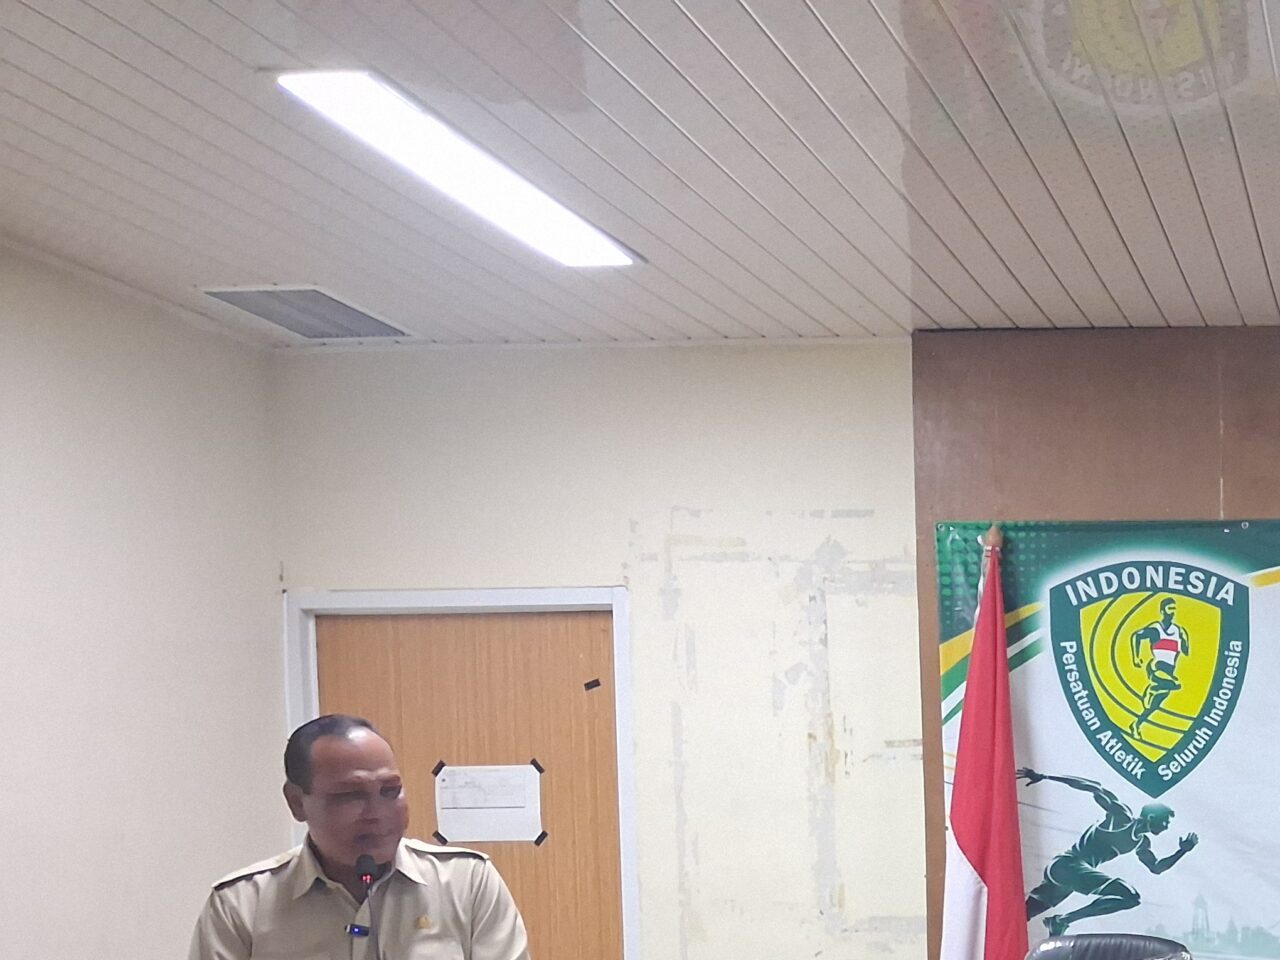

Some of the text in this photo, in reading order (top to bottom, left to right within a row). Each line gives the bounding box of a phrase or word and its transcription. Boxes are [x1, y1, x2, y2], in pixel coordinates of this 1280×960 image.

[1065, 565, 1235, 606] INDONESIA
[1060, 641, 1146, 779] Persatuan Atletik
[1158, 640, 1243, 780] Seluruh Indonesia
